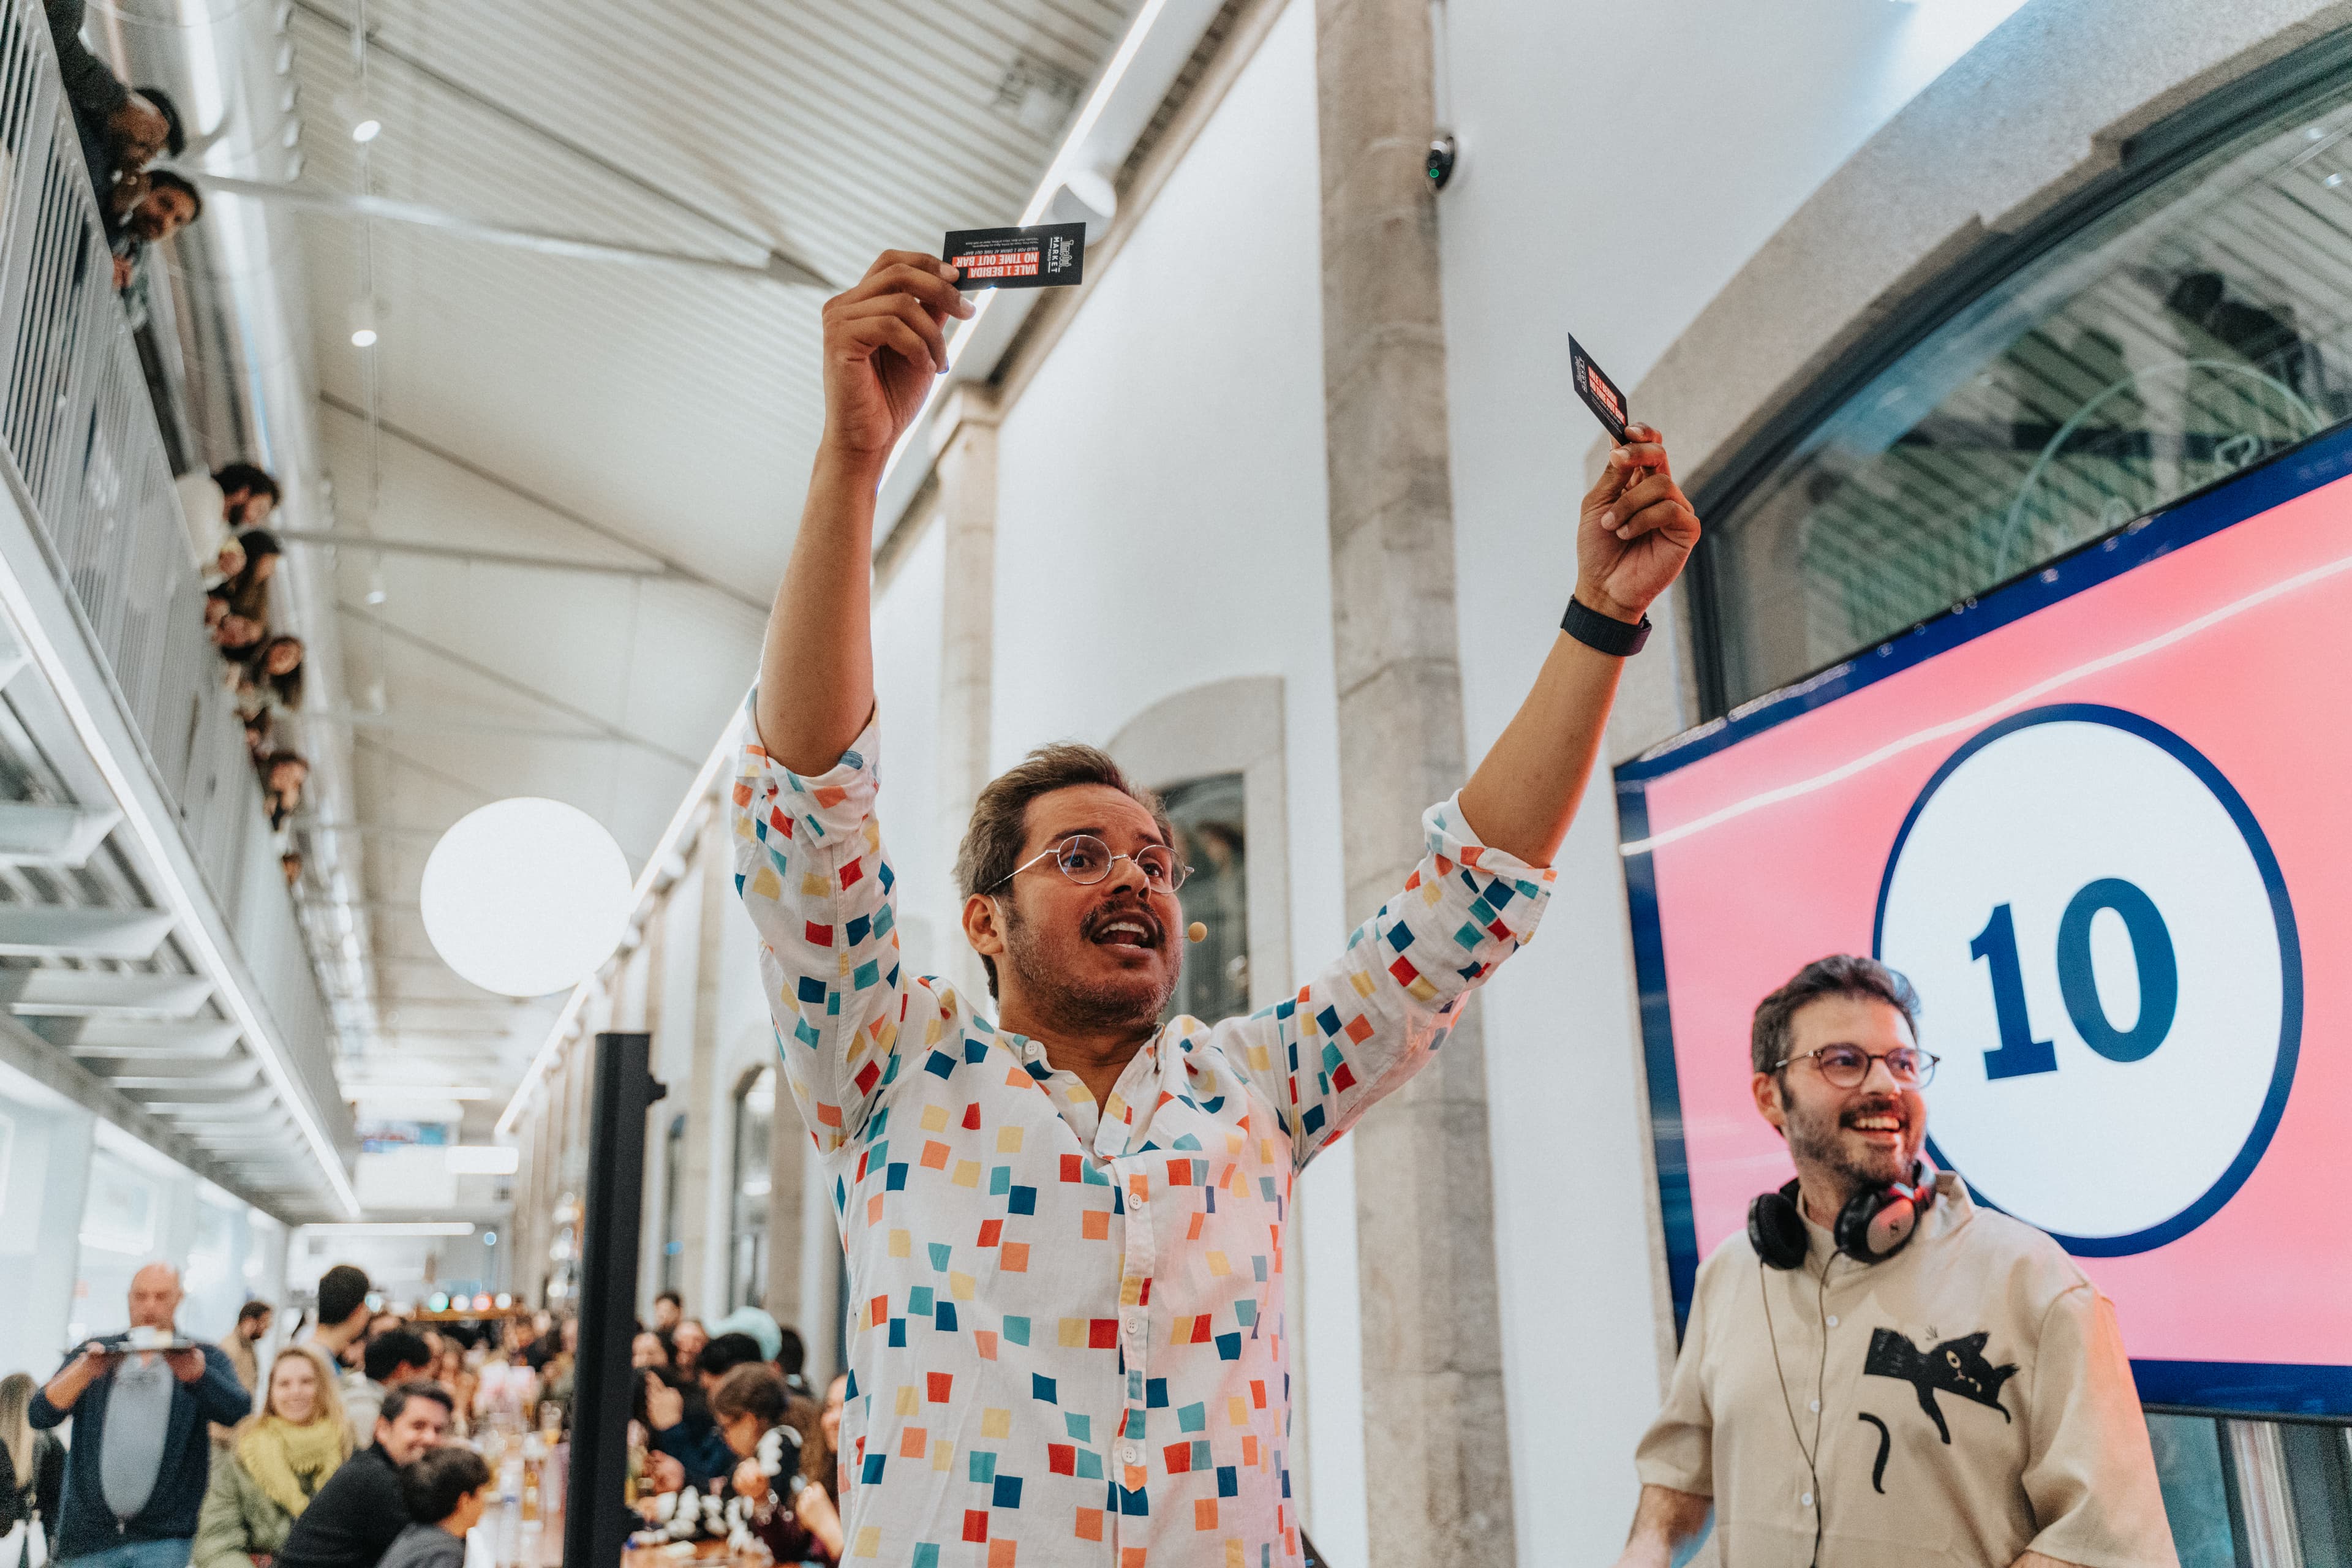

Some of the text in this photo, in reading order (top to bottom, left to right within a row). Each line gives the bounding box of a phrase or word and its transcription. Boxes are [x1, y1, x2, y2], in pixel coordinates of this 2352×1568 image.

[977, 255, 997, 266] OUT
[998, 254, 1022, 265] TIME
[1023, 252, 1038, 263] NO
[1051, 236, 1060, 273] MARKET
[970, 264, 1036, 277] VALE 1 BEBIDA
[1970, 877, 2178, 1080] 10
